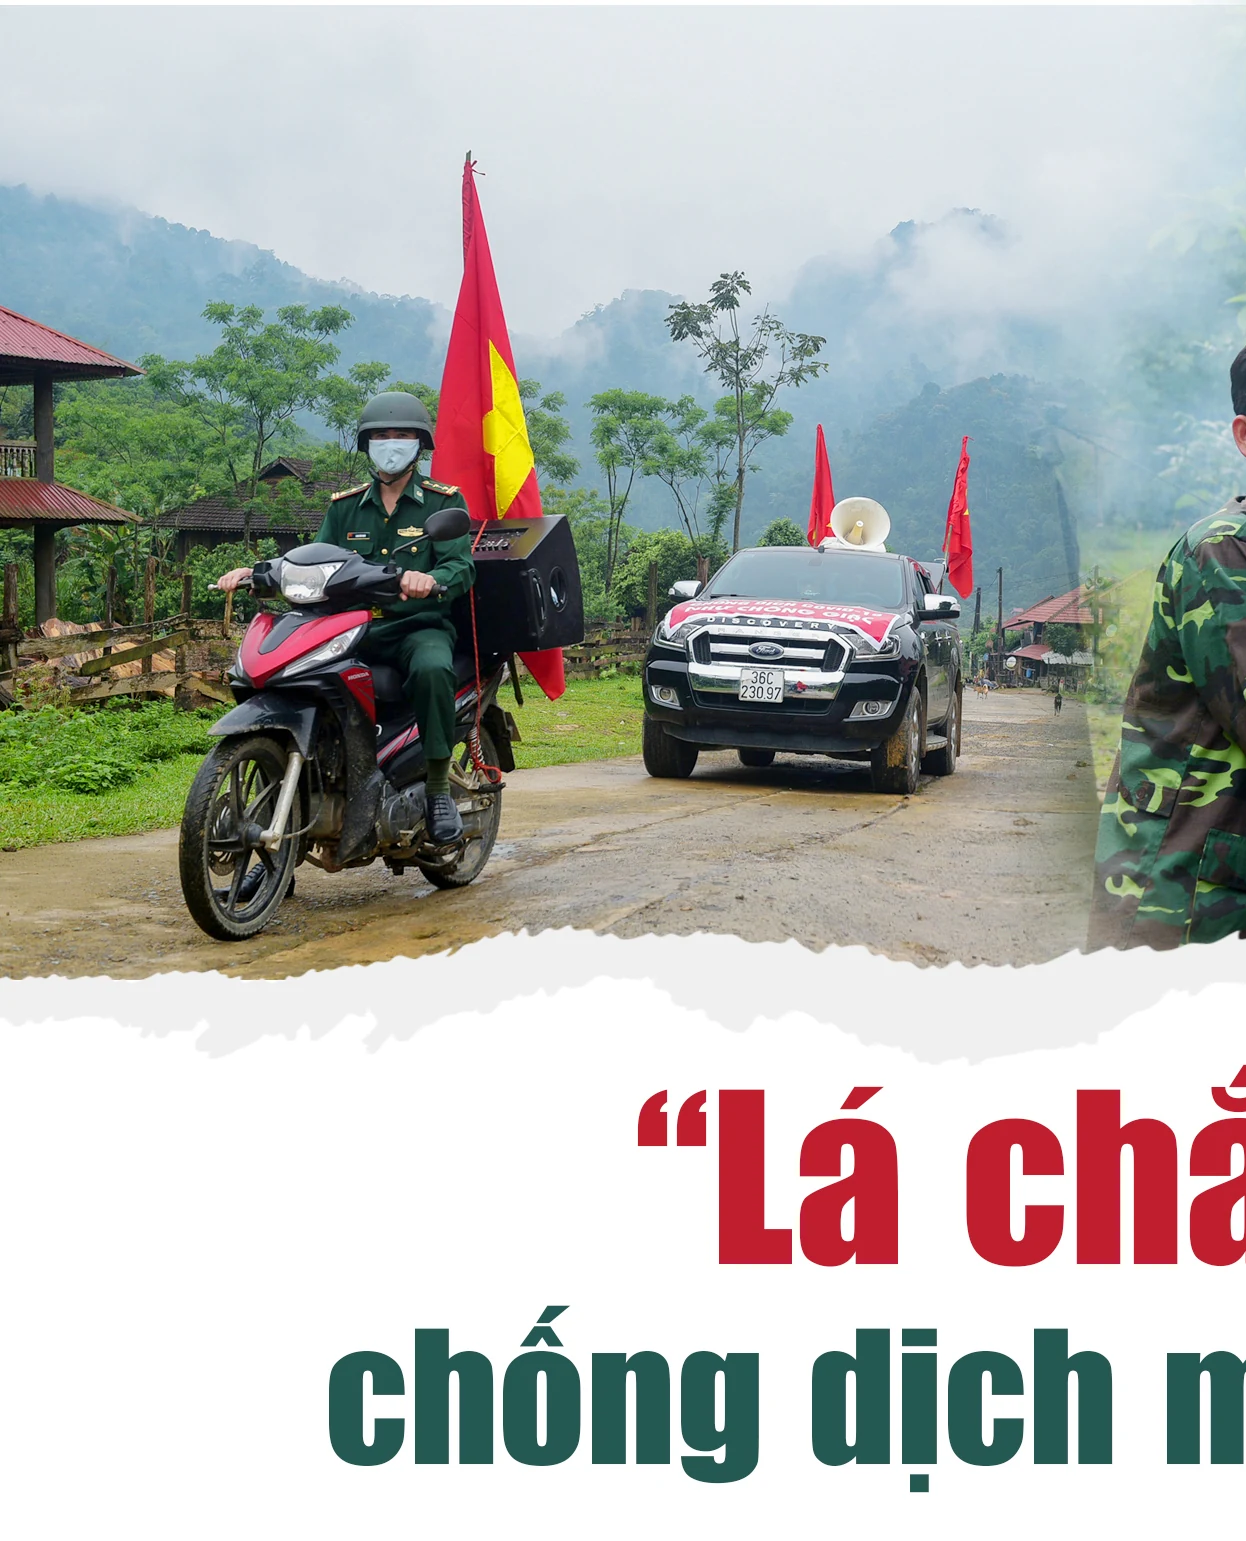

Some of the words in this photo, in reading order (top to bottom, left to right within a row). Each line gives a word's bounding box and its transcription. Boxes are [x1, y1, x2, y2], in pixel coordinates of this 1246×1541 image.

[707, 617, 835, 630] DISCOVERY
[348, 672, 369, 680] HONDA
[751, 671, 774, 685] 36C
[741, 685, 781, 700] 230.97
